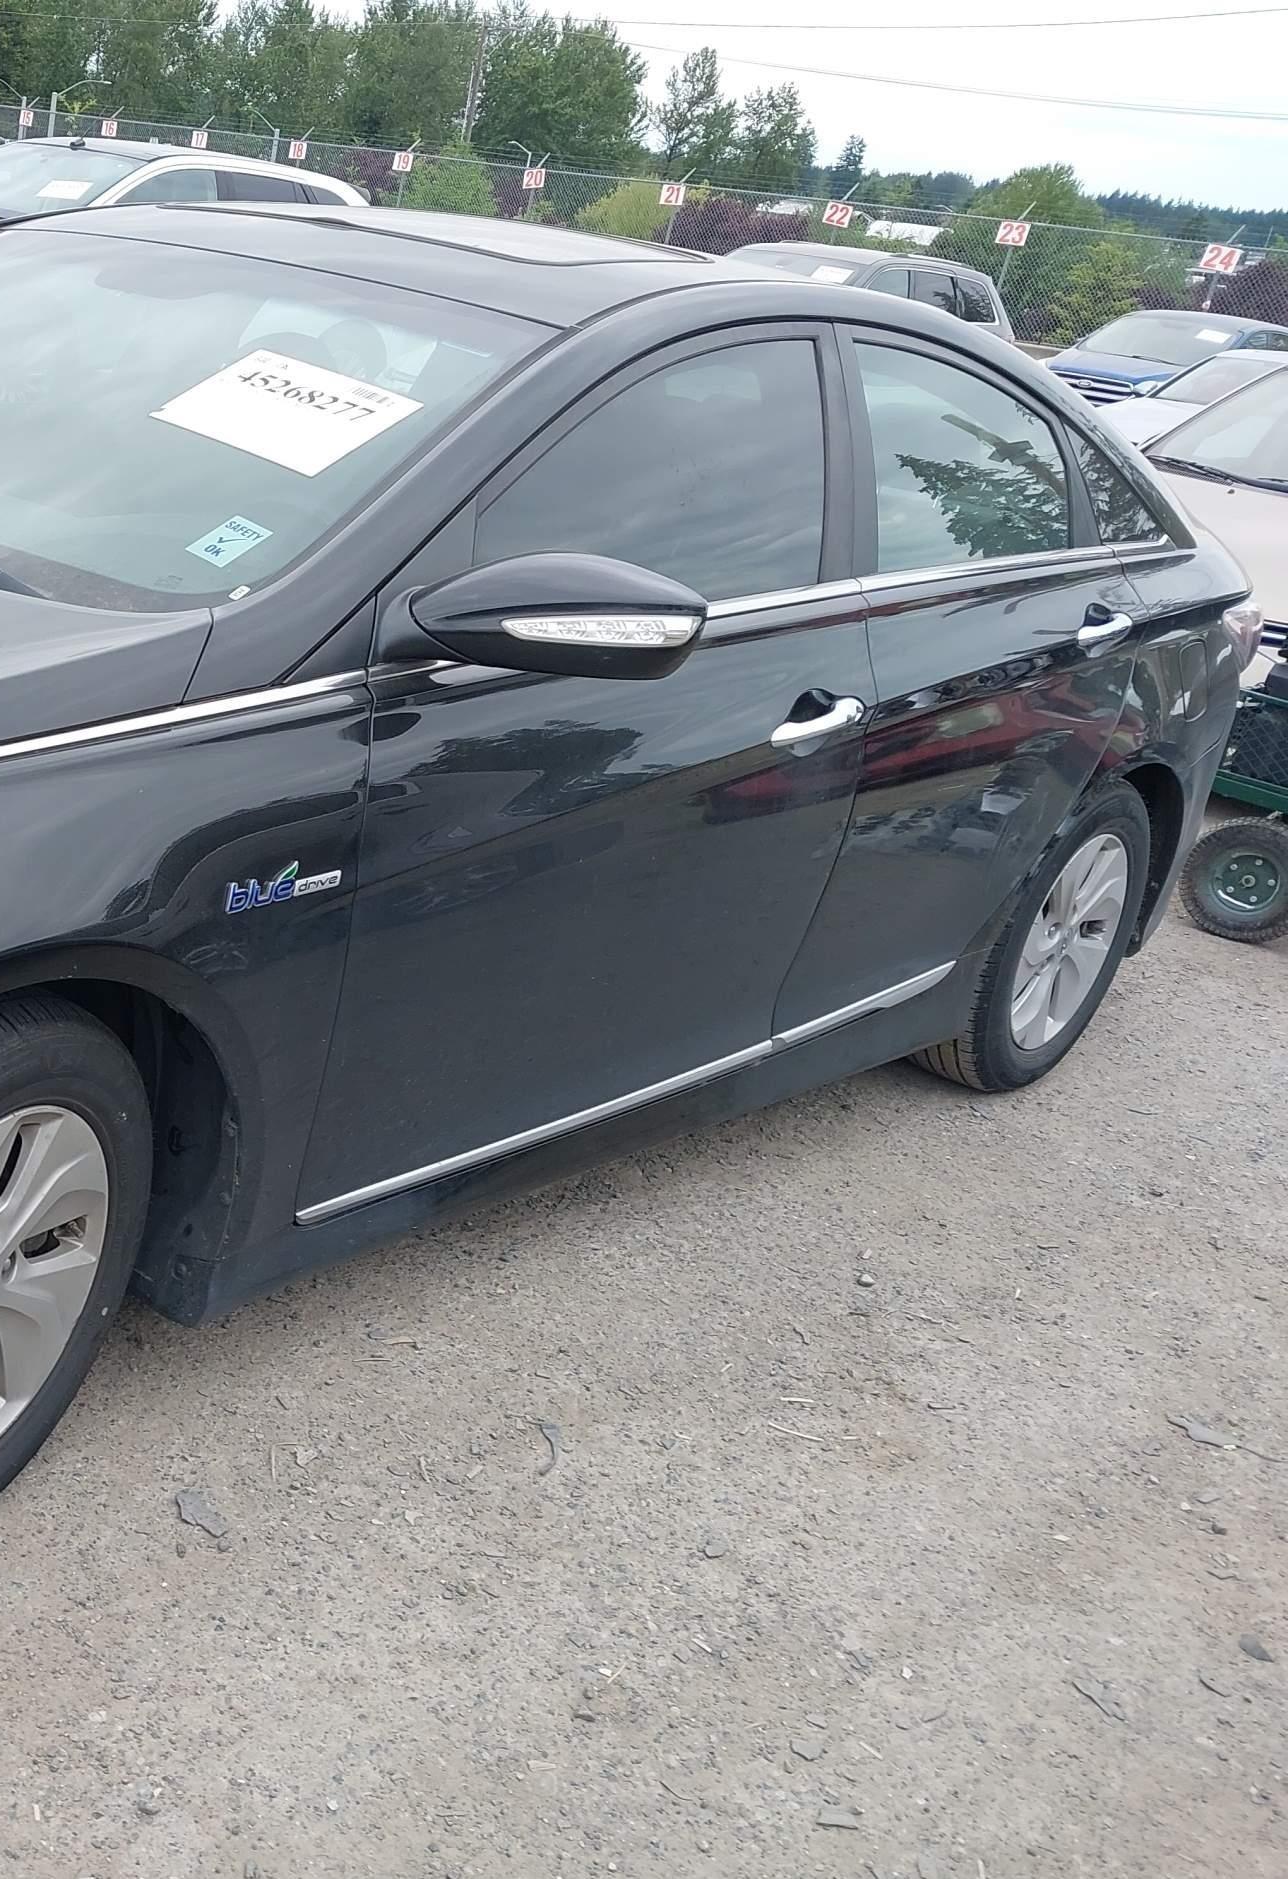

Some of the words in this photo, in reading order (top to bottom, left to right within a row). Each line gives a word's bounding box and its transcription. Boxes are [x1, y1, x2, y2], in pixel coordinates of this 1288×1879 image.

[22, 111, 31, 125] 15
[105, 122, 115, 136] 16
[195, 132, 205, 147] 17
[292, 143, 304, 158] 18
[397, 154, 410, 170] 19
[526, 170, 543, 188] 20
[664, 186, 681, 204] 21
[825, 203, 851, 226] 22
[998, 223, 1027, 244] 23
[1202, 246, 1238, 272] 24
[237, 371, 376, 421] 45268277
[224, 520, 264, 541] SAFETY
[203, 544, 227, 557] OK
[224, 878, 296, 915] blue
[297, 874, 339, 893] drive
